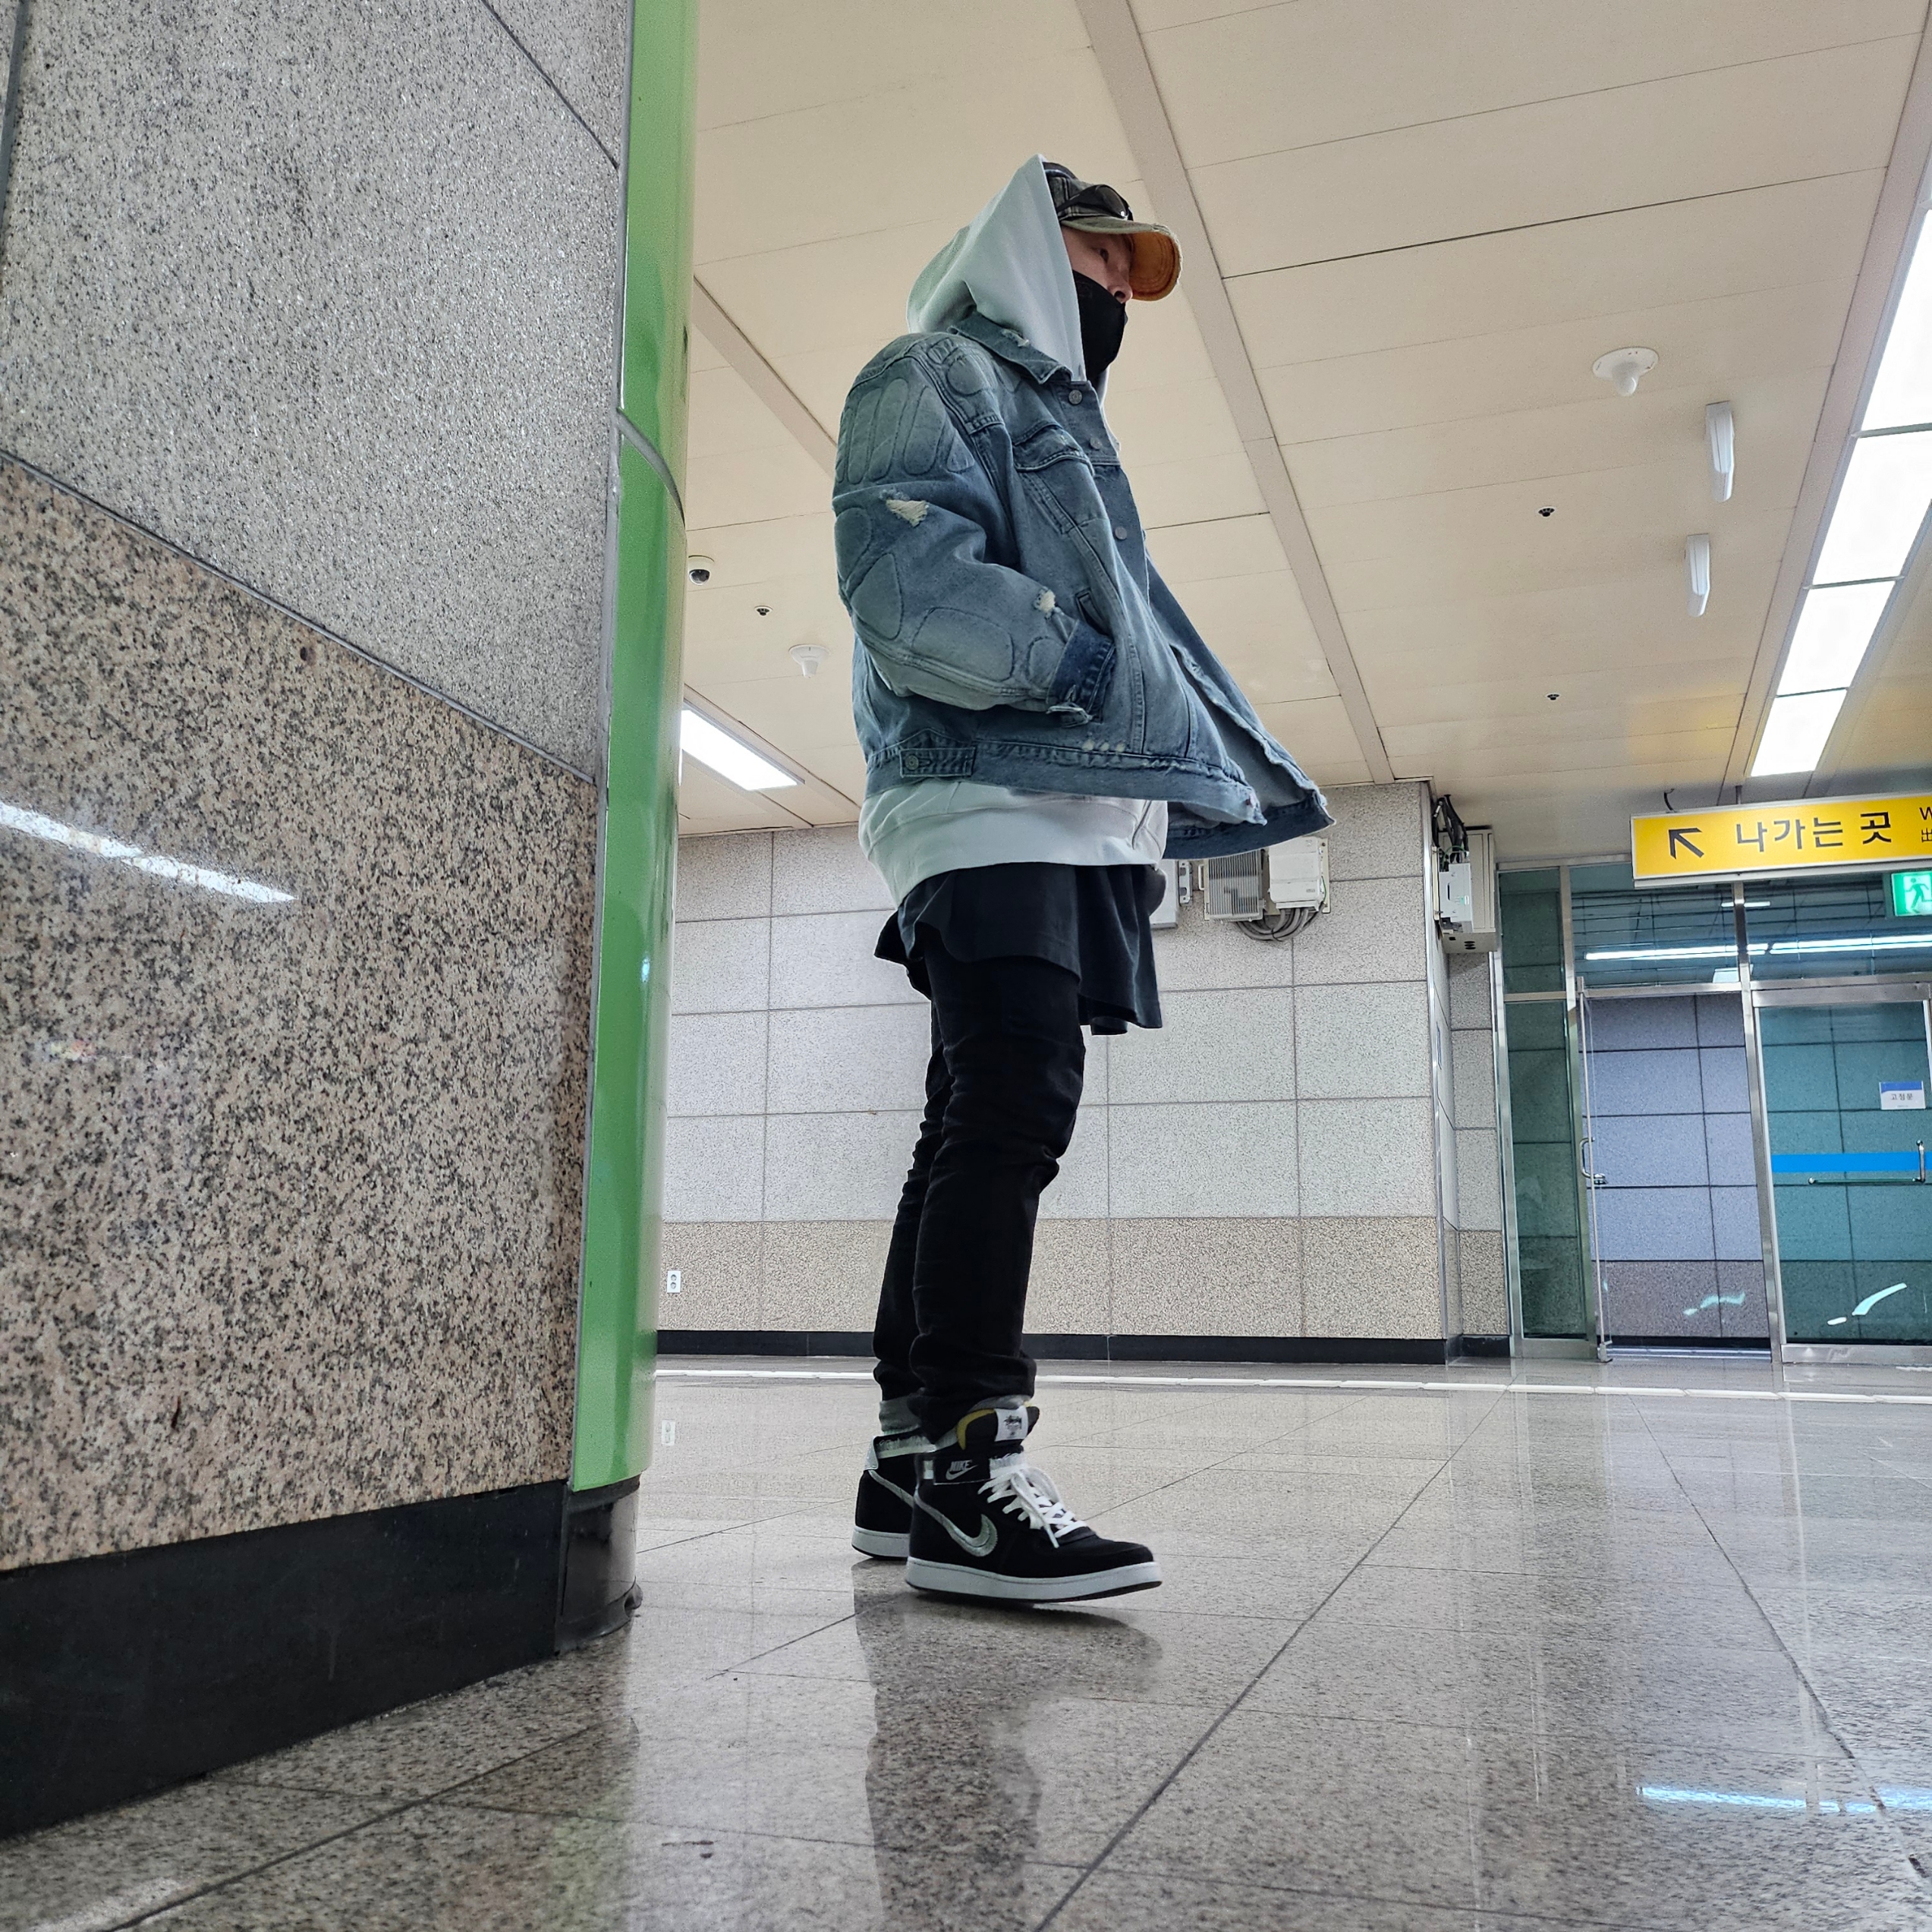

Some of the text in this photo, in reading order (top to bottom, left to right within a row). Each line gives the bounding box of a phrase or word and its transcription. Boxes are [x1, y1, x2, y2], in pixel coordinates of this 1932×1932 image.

[1736, 811, 1892, 852] 나가는 곳
[949, 1459, 973, 1471] NIKE
